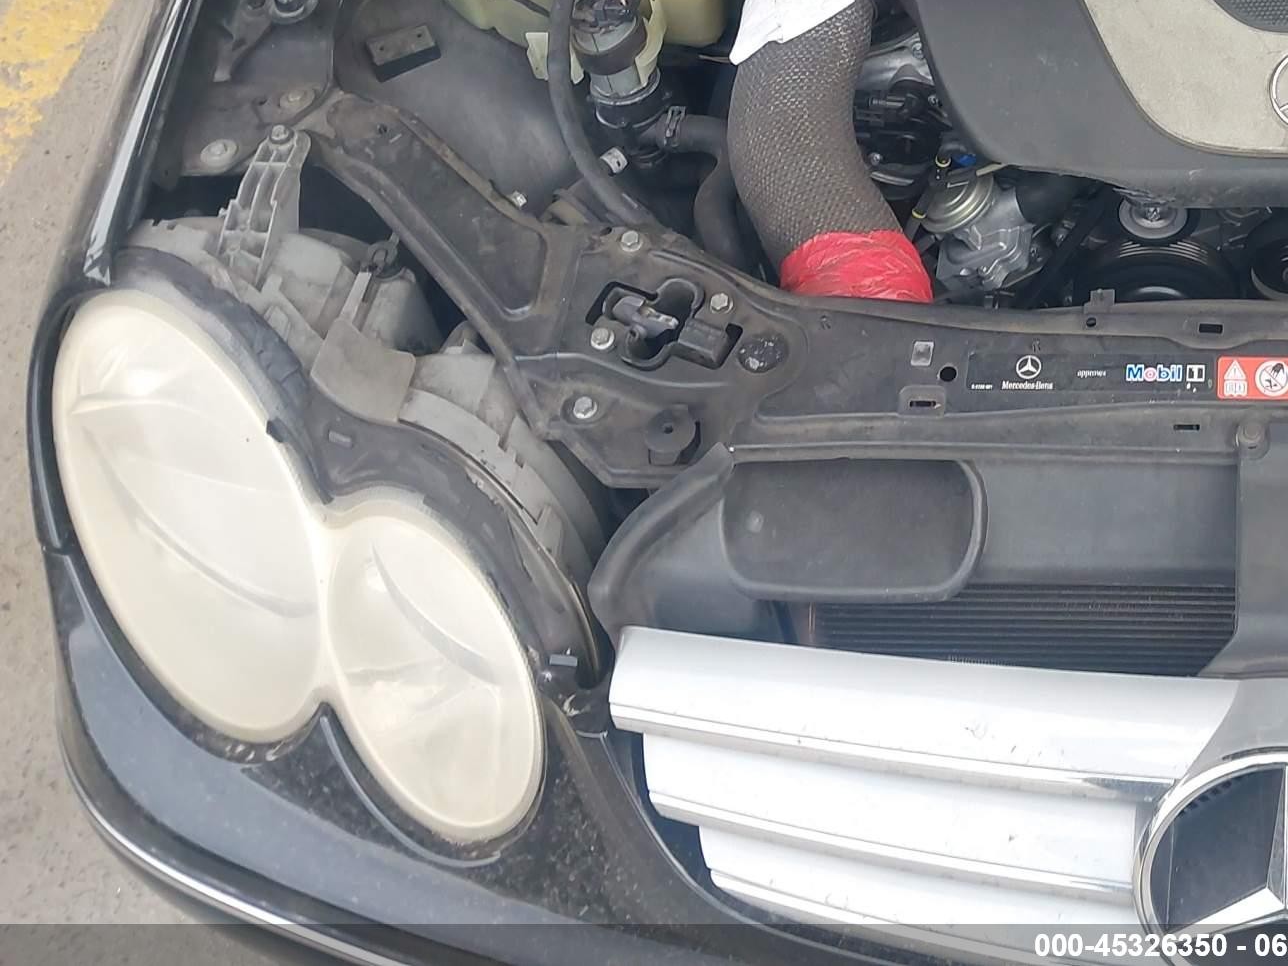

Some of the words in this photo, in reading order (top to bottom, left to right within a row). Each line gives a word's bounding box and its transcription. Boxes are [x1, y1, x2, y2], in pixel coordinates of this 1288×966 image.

[1125, 364, 1183, 382] Mobil
[1187, 365, 1204, 382] 1
[1001, 380, 1054, 390] Mercedes-Benz
